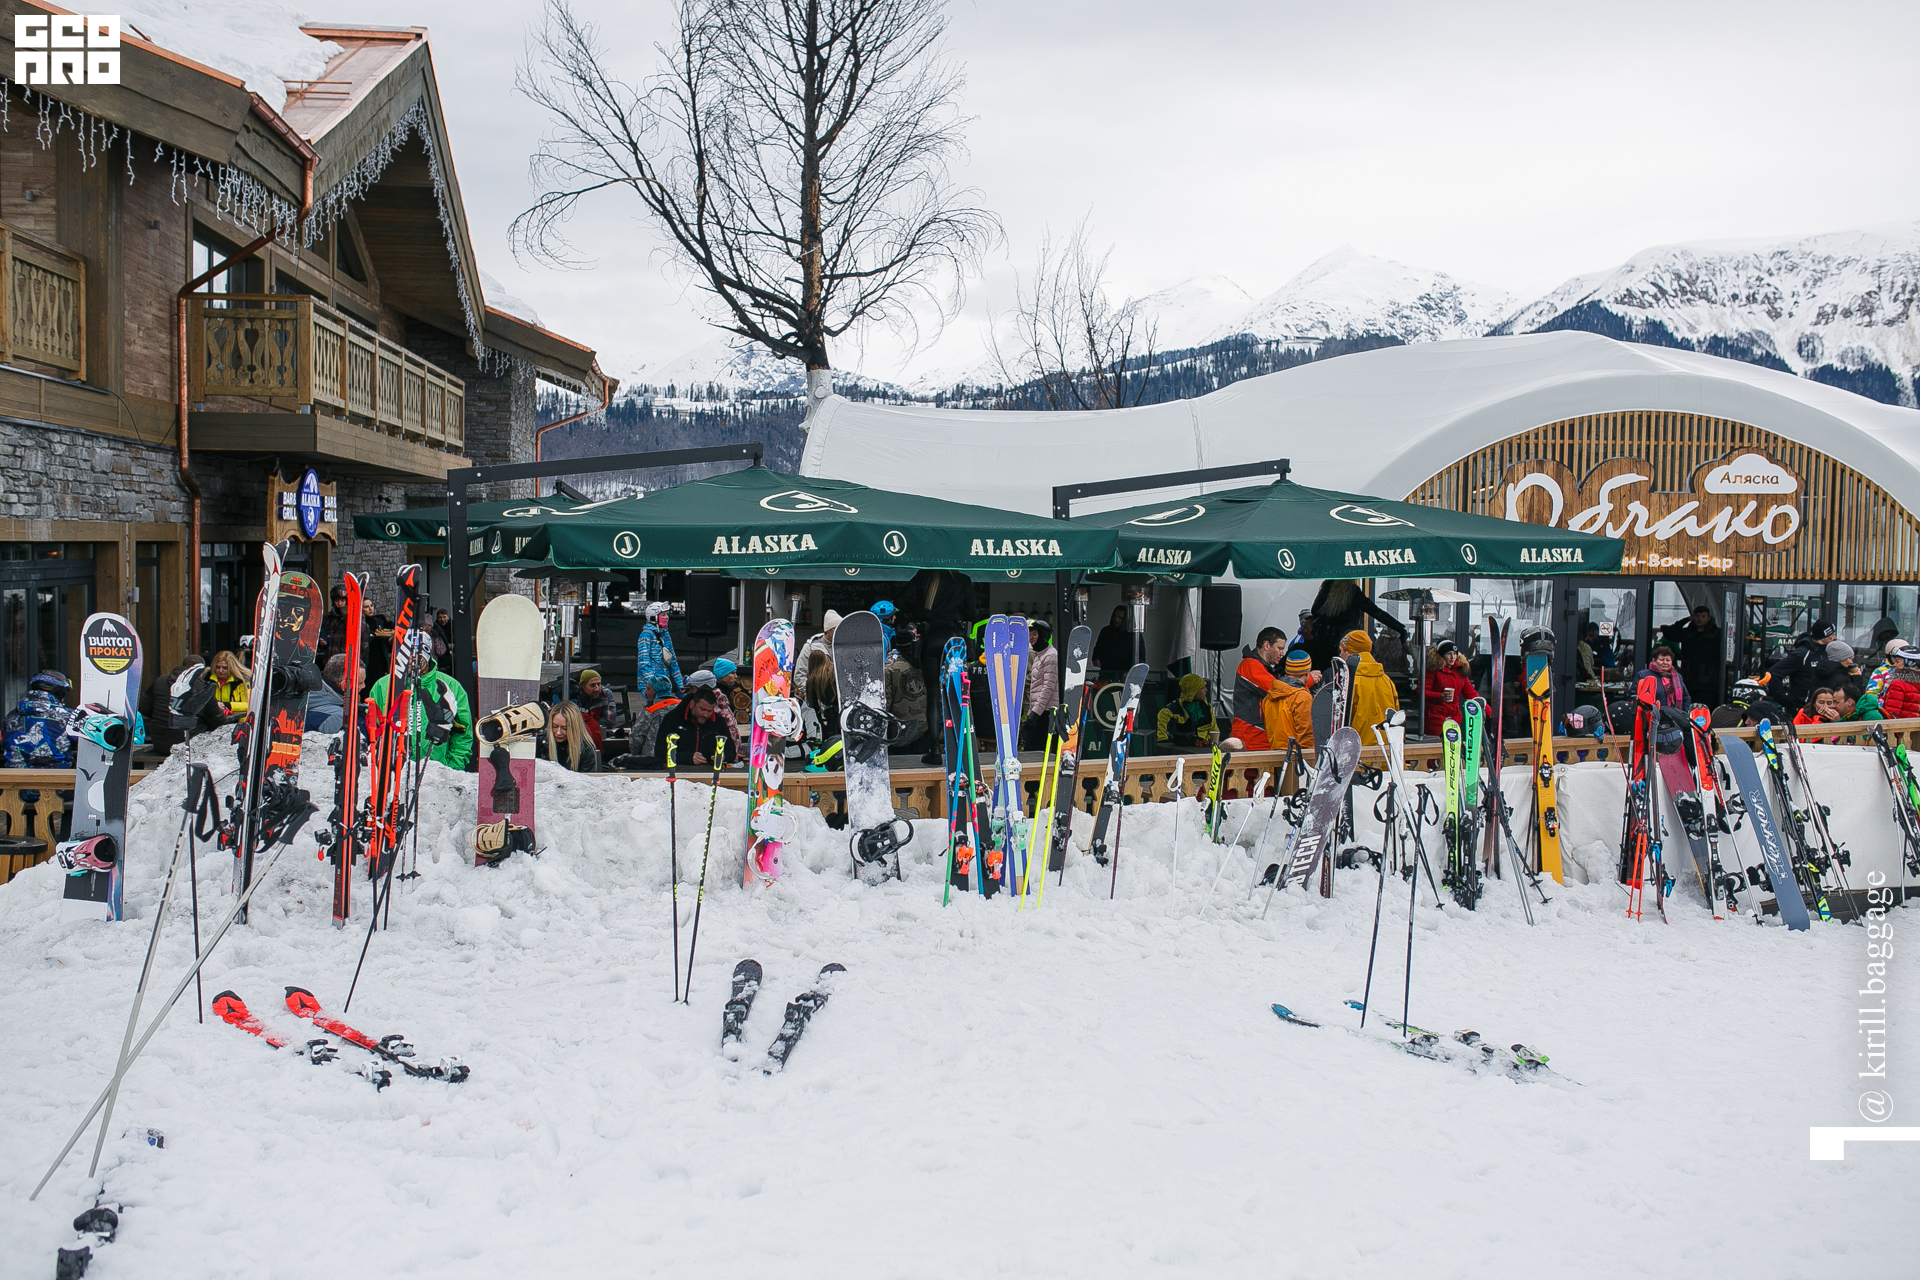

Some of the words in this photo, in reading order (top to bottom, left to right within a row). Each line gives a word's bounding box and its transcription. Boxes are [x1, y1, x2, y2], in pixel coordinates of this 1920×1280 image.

[1719, 471, 1779, 486] Аляска
[301, 493, 320, 508] ALASKA
[712, 534, 818, 555] ALASKA
[969, 539, 1063, 557] ALASKA
[1137, 547, 1192, 565] ALASKA
[1344, 548, 1416, 567] ALASKA
[1520, 548, 1584, 564] ALASKA
[88, 636, 132, 647] BURTON
[88, 647, 133, 657] ПРОКАТ
